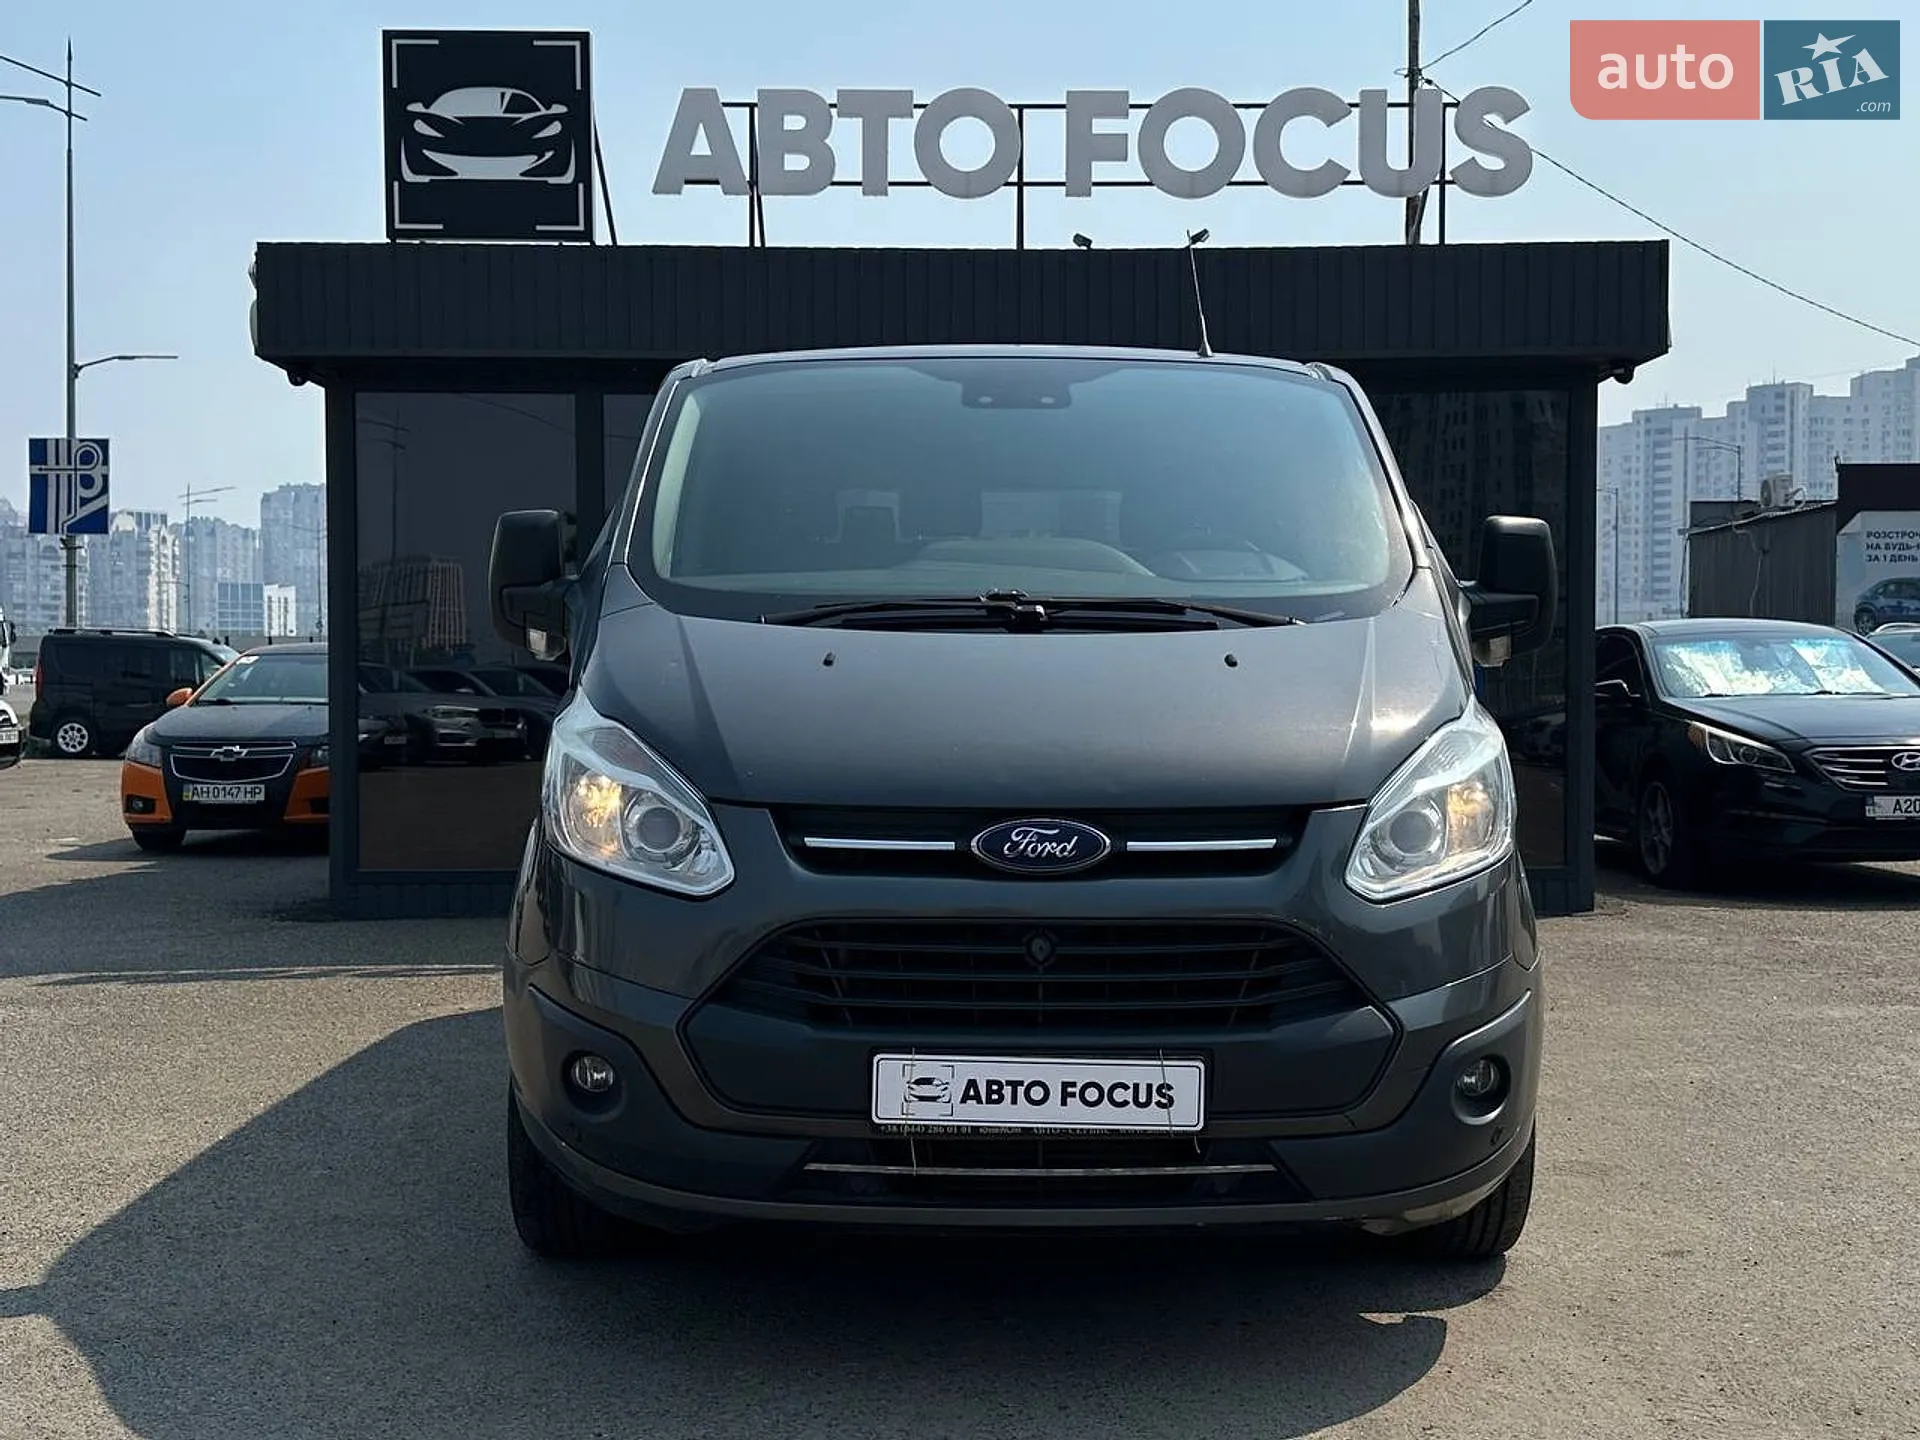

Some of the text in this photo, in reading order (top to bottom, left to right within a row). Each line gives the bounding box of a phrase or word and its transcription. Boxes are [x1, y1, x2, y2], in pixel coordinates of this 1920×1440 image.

[652, 86, 1533, 199] АВТО FOCUS
[212, 786, 241, 799] 0147
[1003, 826, 1078, 858] Ford
[960, 1078, 1175, 1110] АВТО FOCUS
